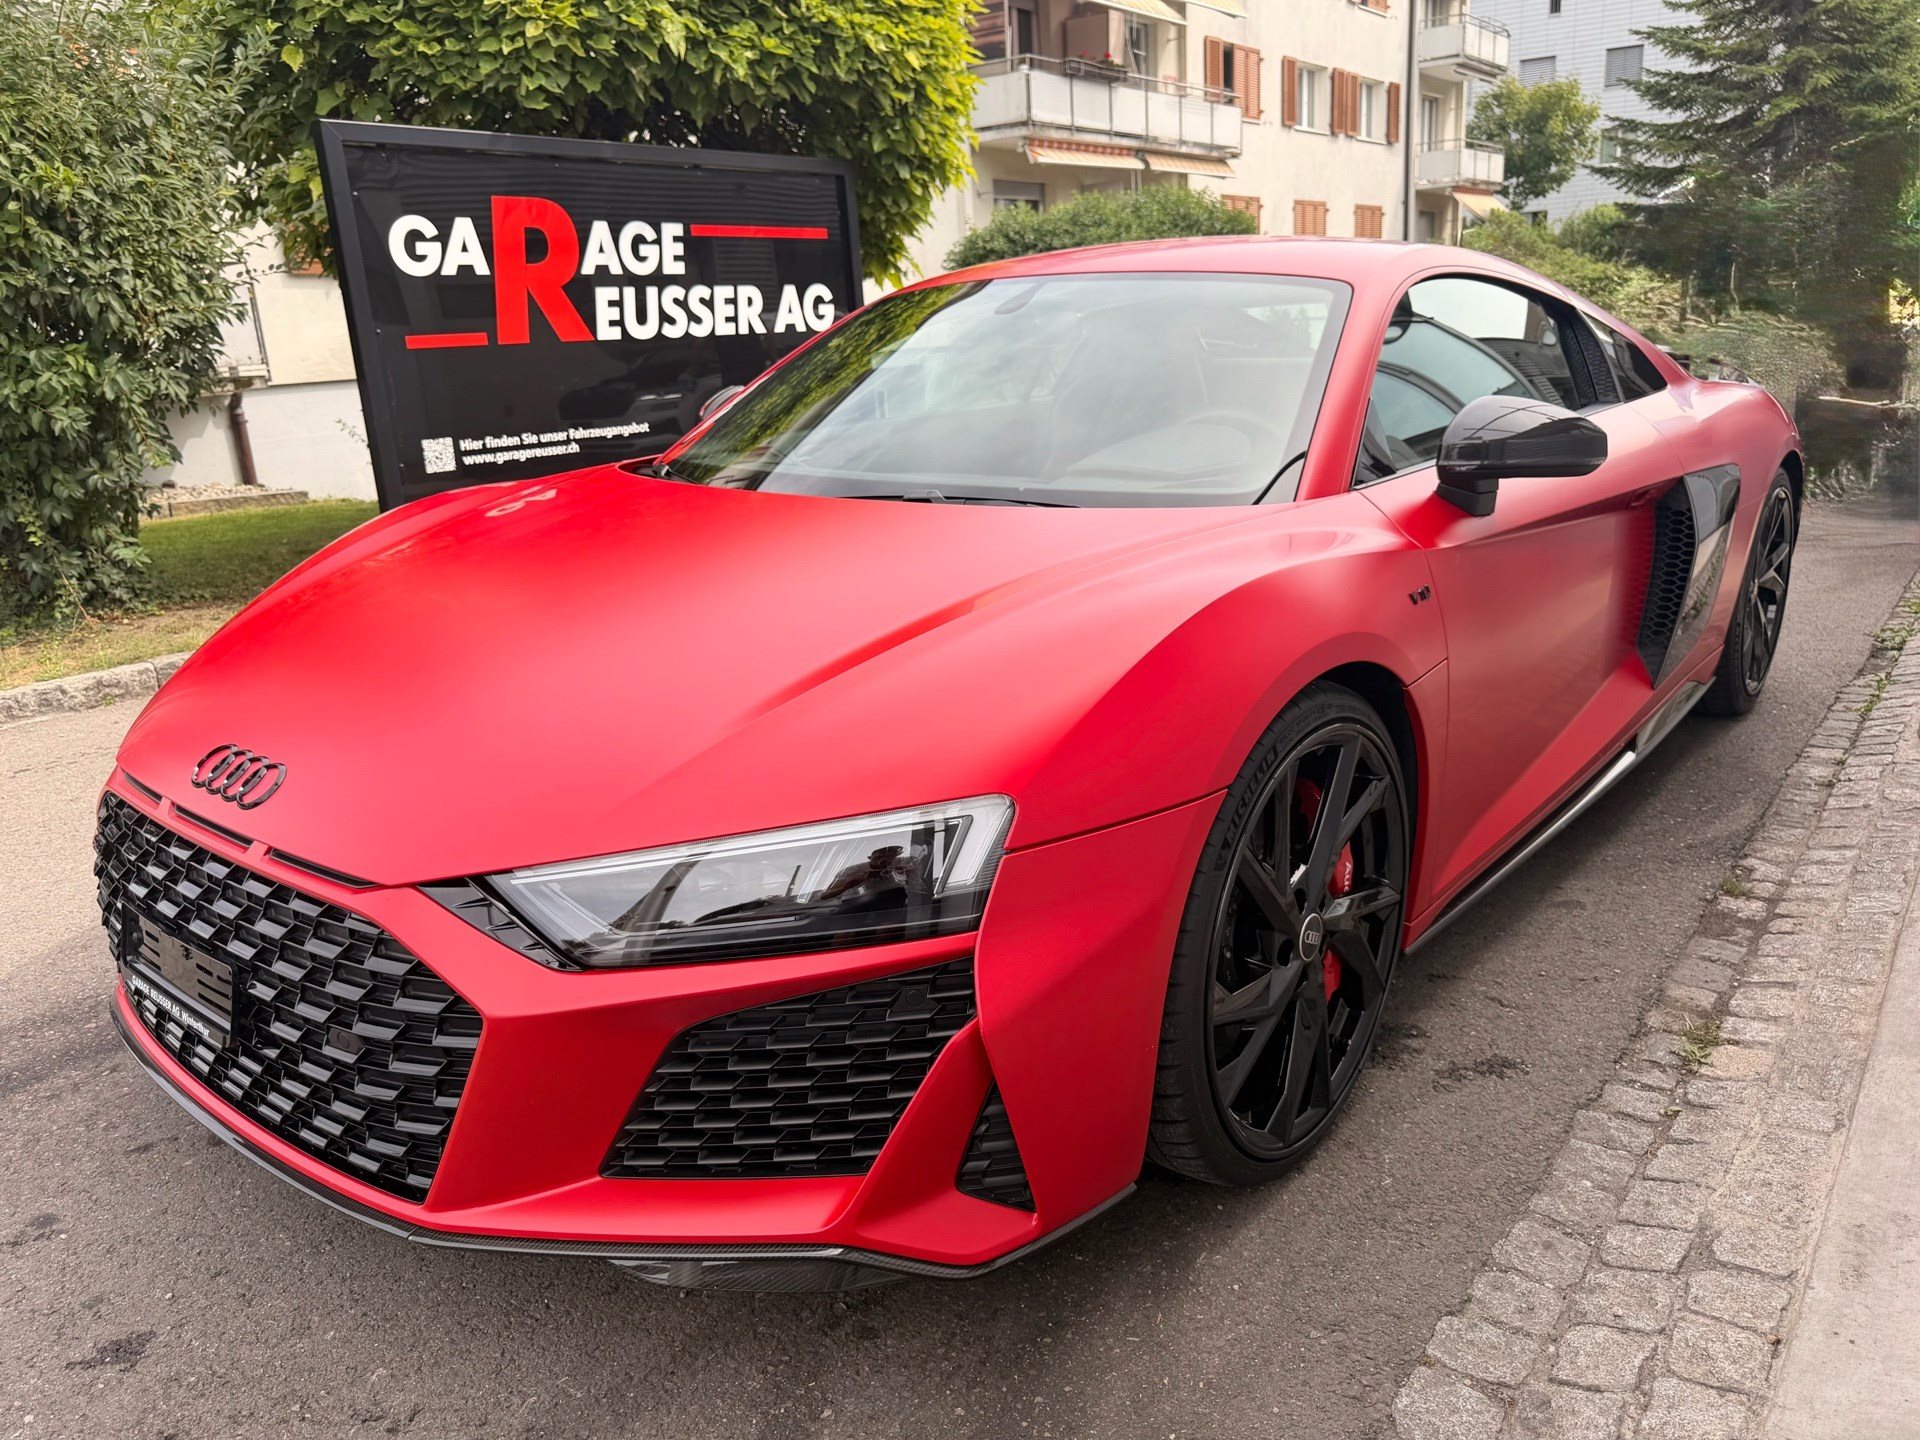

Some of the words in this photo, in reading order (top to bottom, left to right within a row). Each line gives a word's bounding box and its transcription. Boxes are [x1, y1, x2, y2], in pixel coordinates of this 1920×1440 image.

[774, 283, 835, 333] AG
[460, 435, 483, 451] Hier
[485, 435, 520, 449] finden
[522, 432, 538, 444] Sie
[540, 431, 567, 443] unser
[568, 422, 650, 440] Fahrzeugangebot
[462, 442, 580, 466] www.garagereusser.ch
[1224, 748, 1275, 842] MICHELIN
[132, 975, 150, 995] GARAGE
[151, 989, 171, 1011] REUSSER
[172, 1005, 180, 1016] AG
